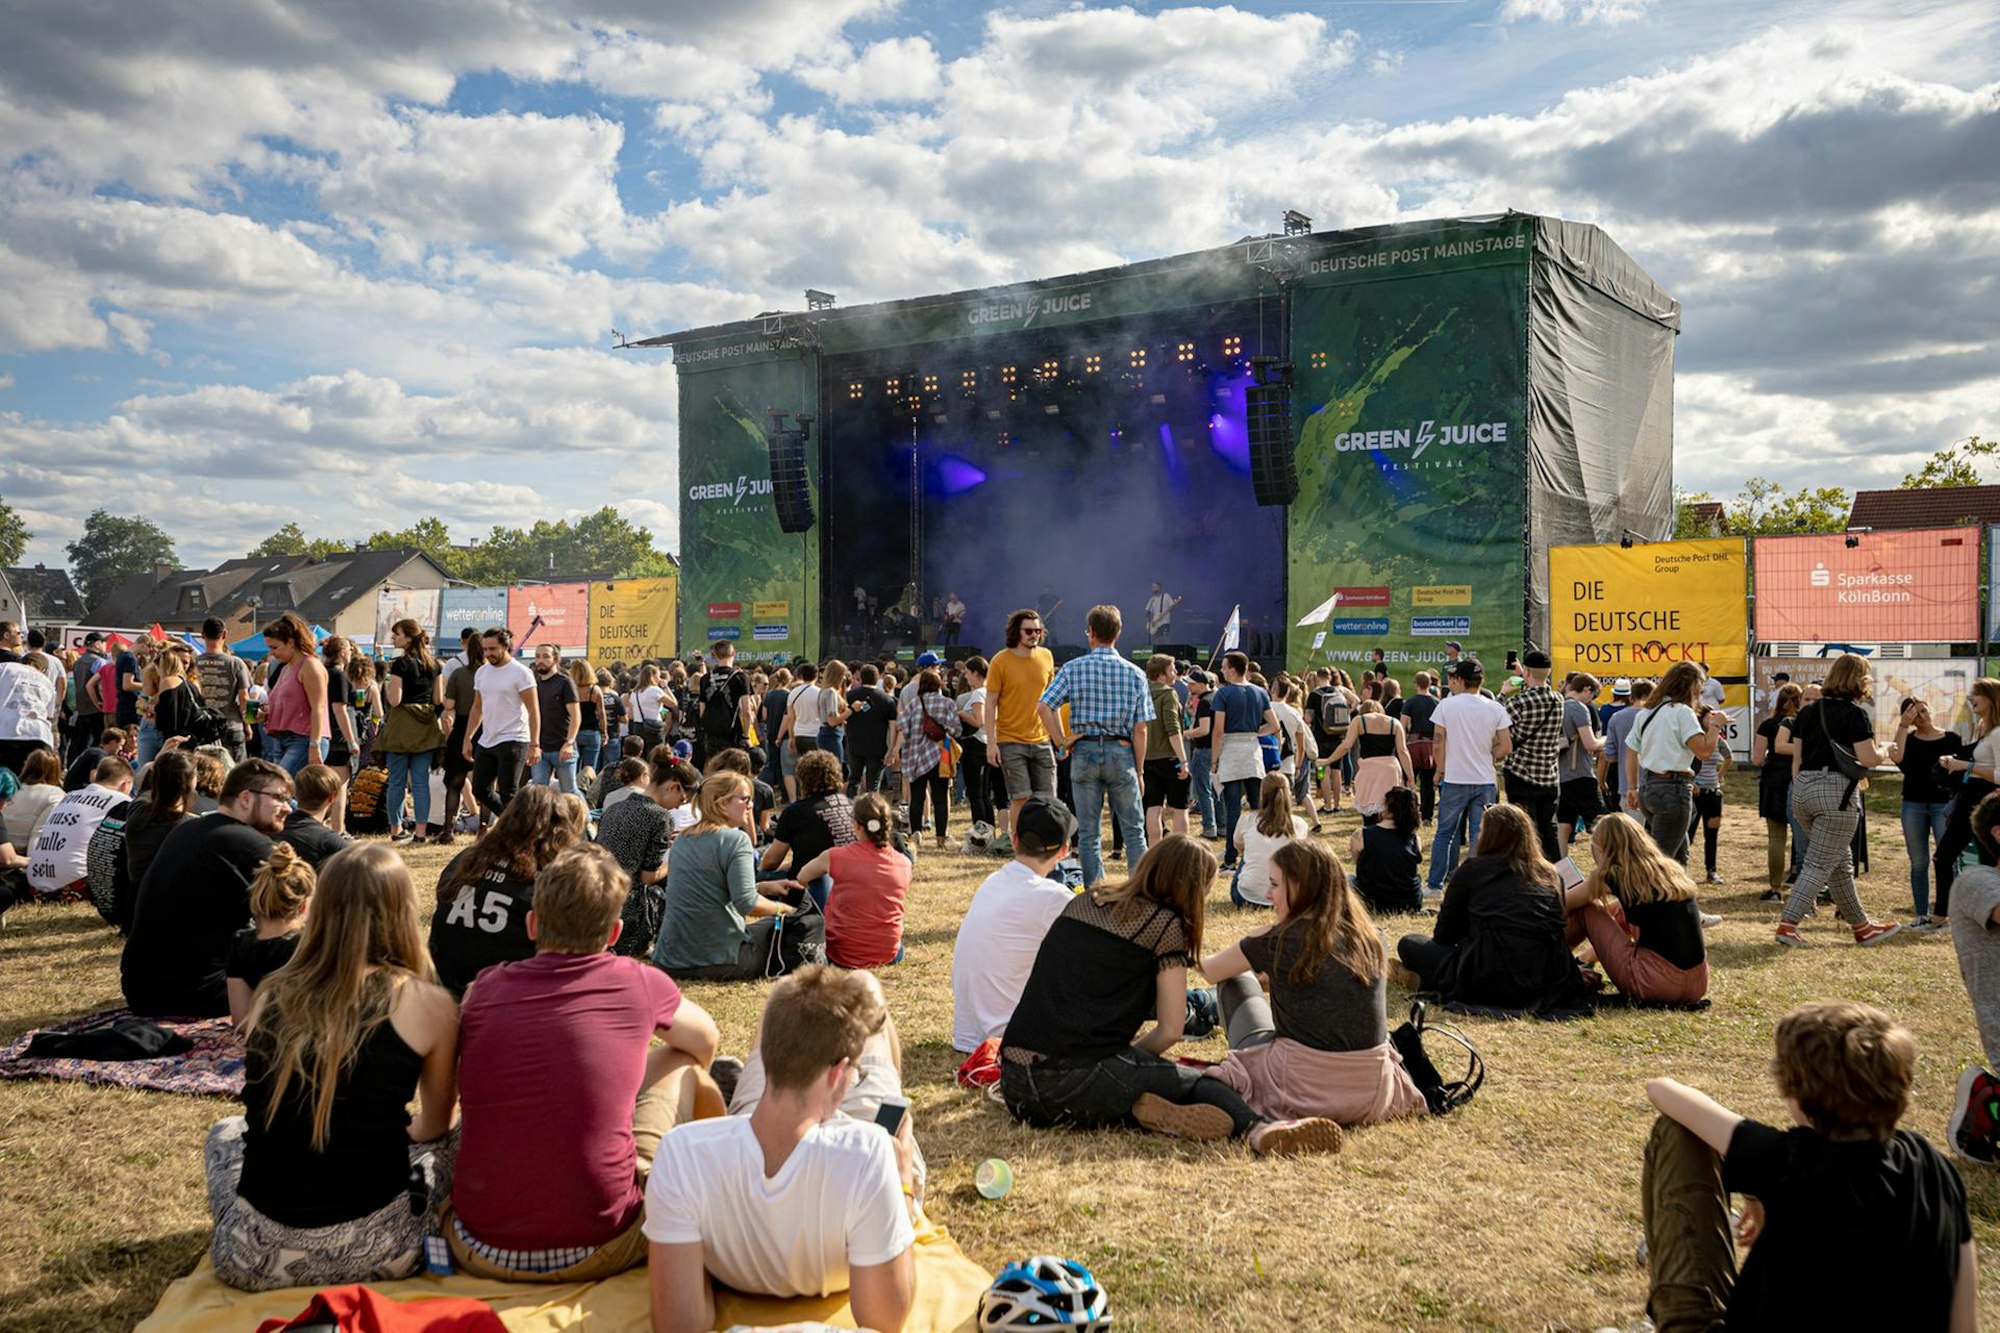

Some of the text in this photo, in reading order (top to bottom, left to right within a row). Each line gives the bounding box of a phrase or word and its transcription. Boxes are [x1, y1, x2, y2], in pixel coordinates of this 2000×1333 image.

[1311, 234, 1525, 274] DEUTSCHE POST MAINSTAGE
[968, 293, 1091, 324] GREEN JUICE
[722, 344, 744, 358] POST
[1334, 422, 1508, 452] GREEN JUICE
[1382, 460, 1463, 471] FESTIVAL
[689, 479, 774, 500] GREEN JUI
[1655, 553, 1729, 564] Deutsche Post DHL
[1655, 565, 1679, 573] Group
[1837, 572, 1912, 588] Sparkasse
[1574, 581, 1604, 600] DIE
[1838, 589, 1910, 604] KölnBonn
[446, 605, 504, 621] wetteronline
[600, 605, 615, 619] DIE
[1335, 621, 1388, 631] wetteronline
[1574, 611, 1680, 632] DEUTSCHE
[600, 624, 648, 639] DEUTSCHE
[599, 646, 623, 660] POST
[1325, 651, 1477, 662] WWW.GEEN-JUICDE
[1575, 641, 1709, 663] POST ROCKT
[32, 859, 56, 878] sein
[484, 869, 506, 883] 019
[446, 884, 513, 933] A5
